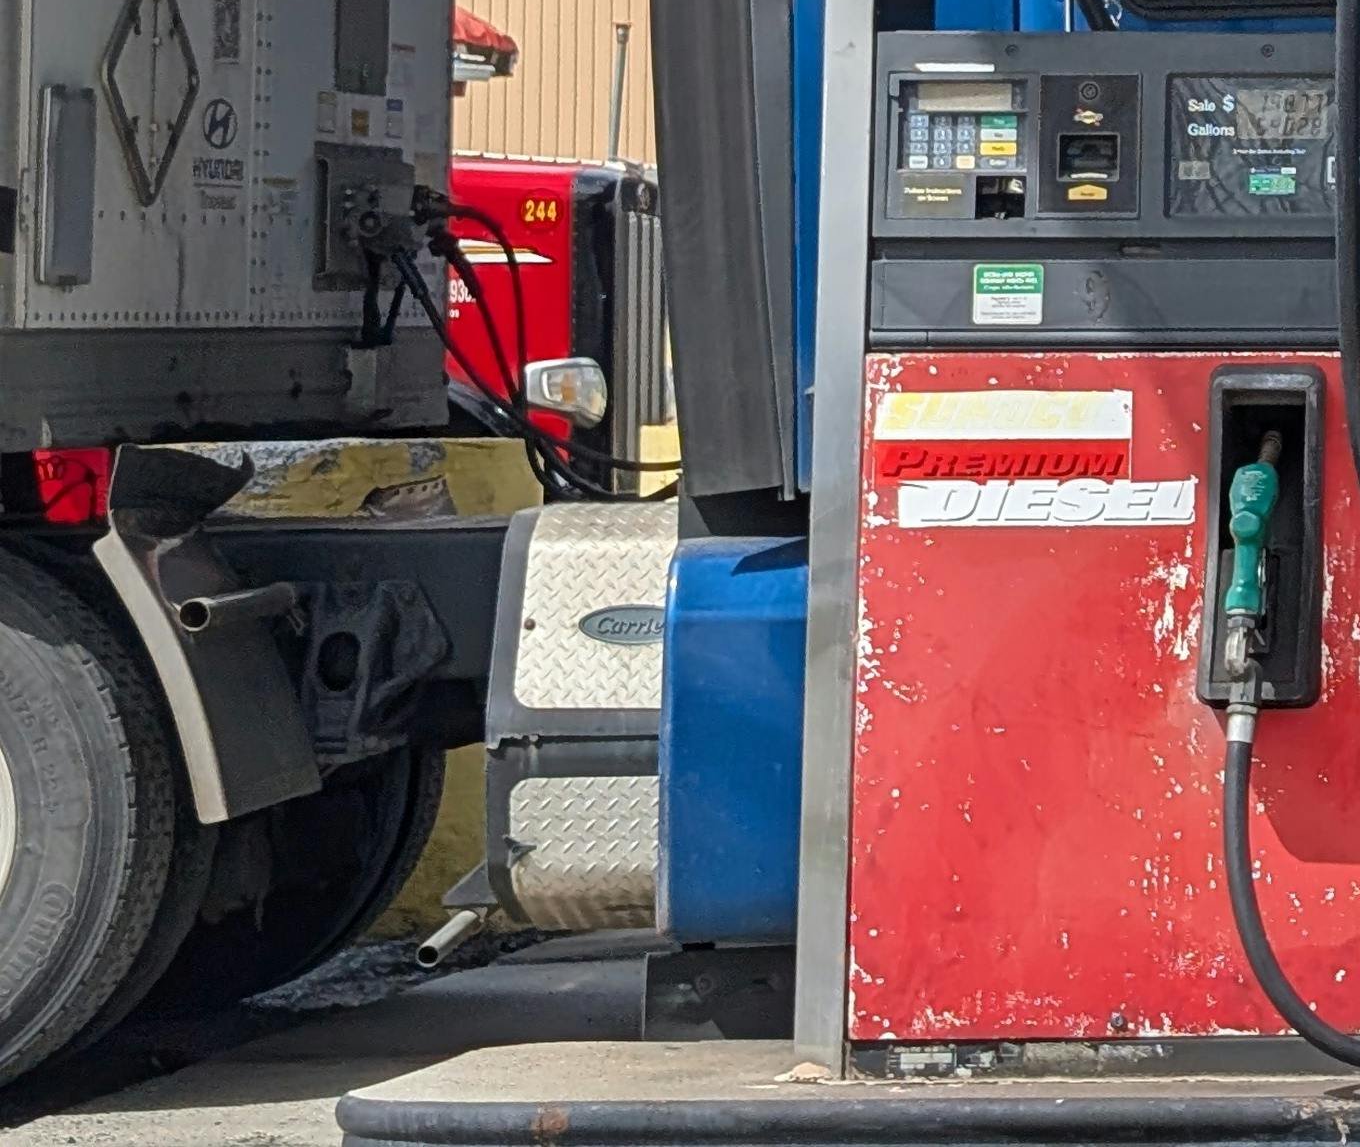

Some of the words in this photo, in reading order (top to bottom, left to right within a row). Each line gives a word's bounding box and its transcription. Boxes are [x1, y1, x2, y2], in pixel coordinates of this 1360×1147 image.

[1187, 98, 1217, 113] Sale
[1222, 93, 1235, 114] $
[1187, 123, 1236, 137] Gallons
[525, 199, 557, 222] 244
[881, 449, 1125, 478] PREMIUM
[915, 480, 1195, 523] DIESEL
